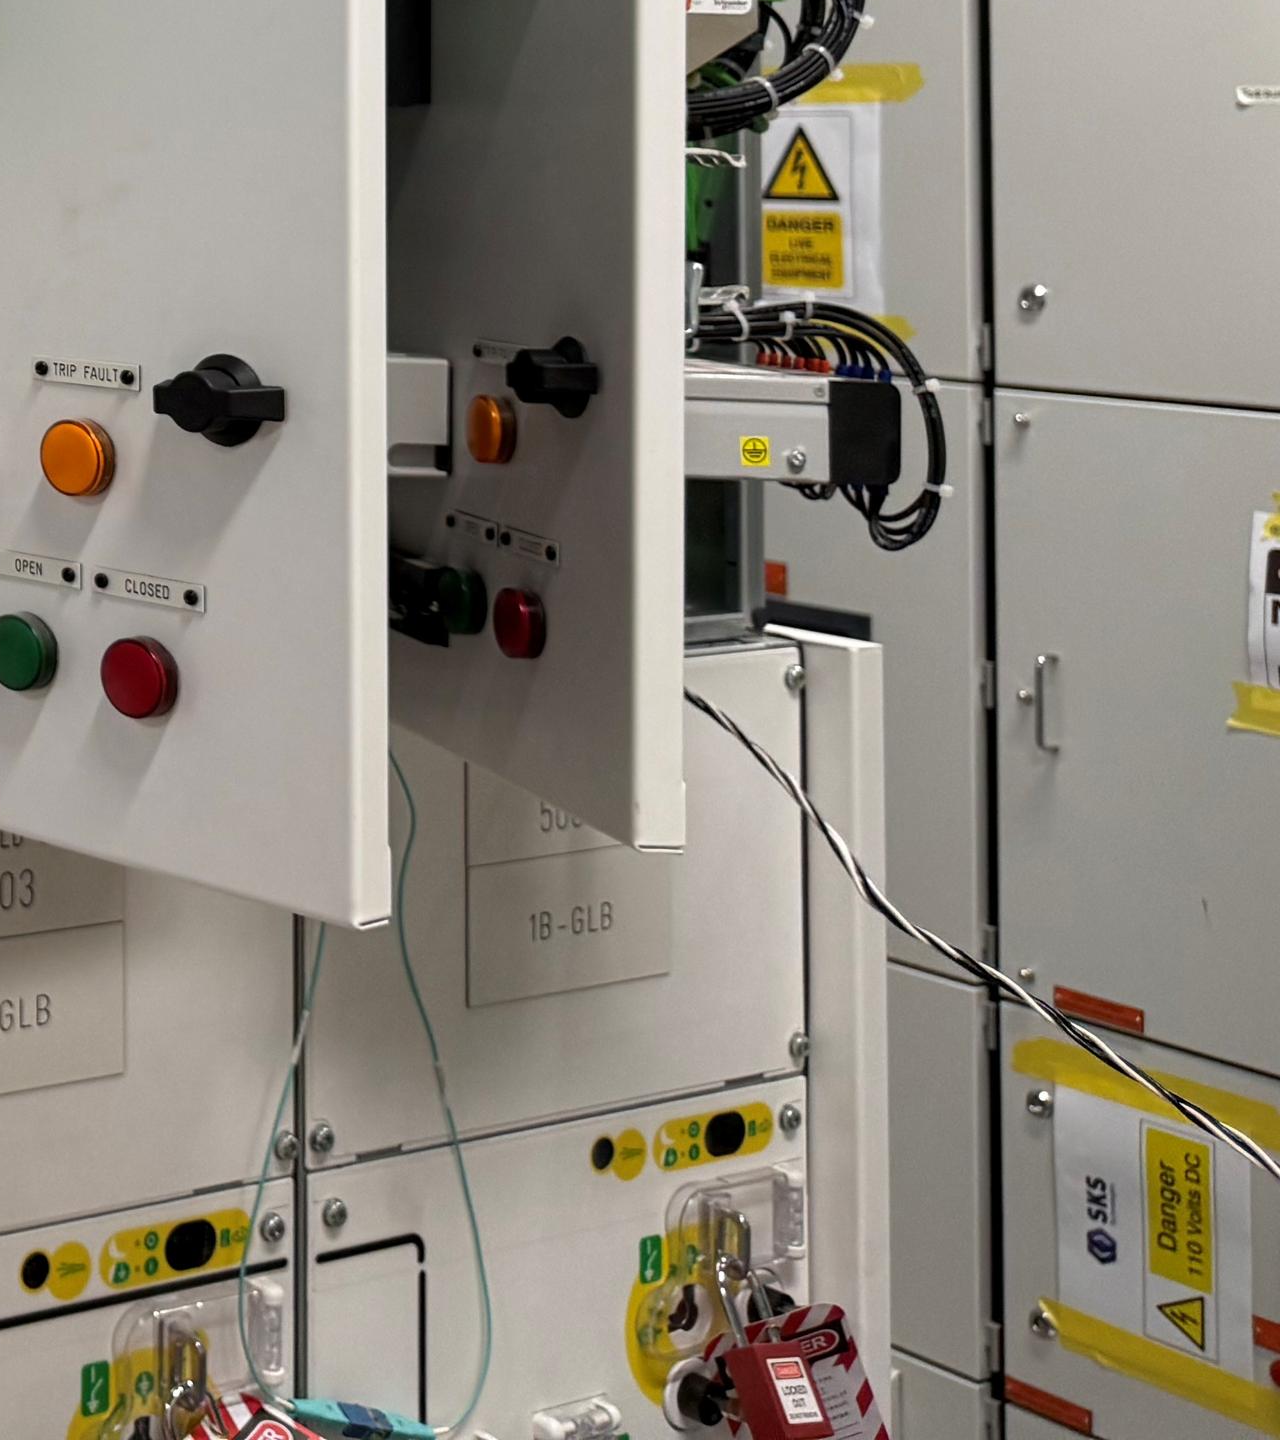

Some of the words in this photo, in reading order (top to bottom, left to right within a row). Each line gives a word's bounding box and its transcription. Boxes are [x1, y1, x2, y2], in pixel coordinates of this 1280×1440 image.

[53, 362, 77, 378] TRIP
[83, 365, 119, 383] FAULT
[14, 558, 43, 576] OPEN
[124, 578, 170, 600] CLOSED
[1184, 1152, 1201, 1185] DC
[1085, 1176, 1108, 1224] SKS
[1157, 1160, 1182, 1253] Danger
[1186, 1190, 1202, 1235] Volts
[1187, 1240, 1203, 1276] 110
